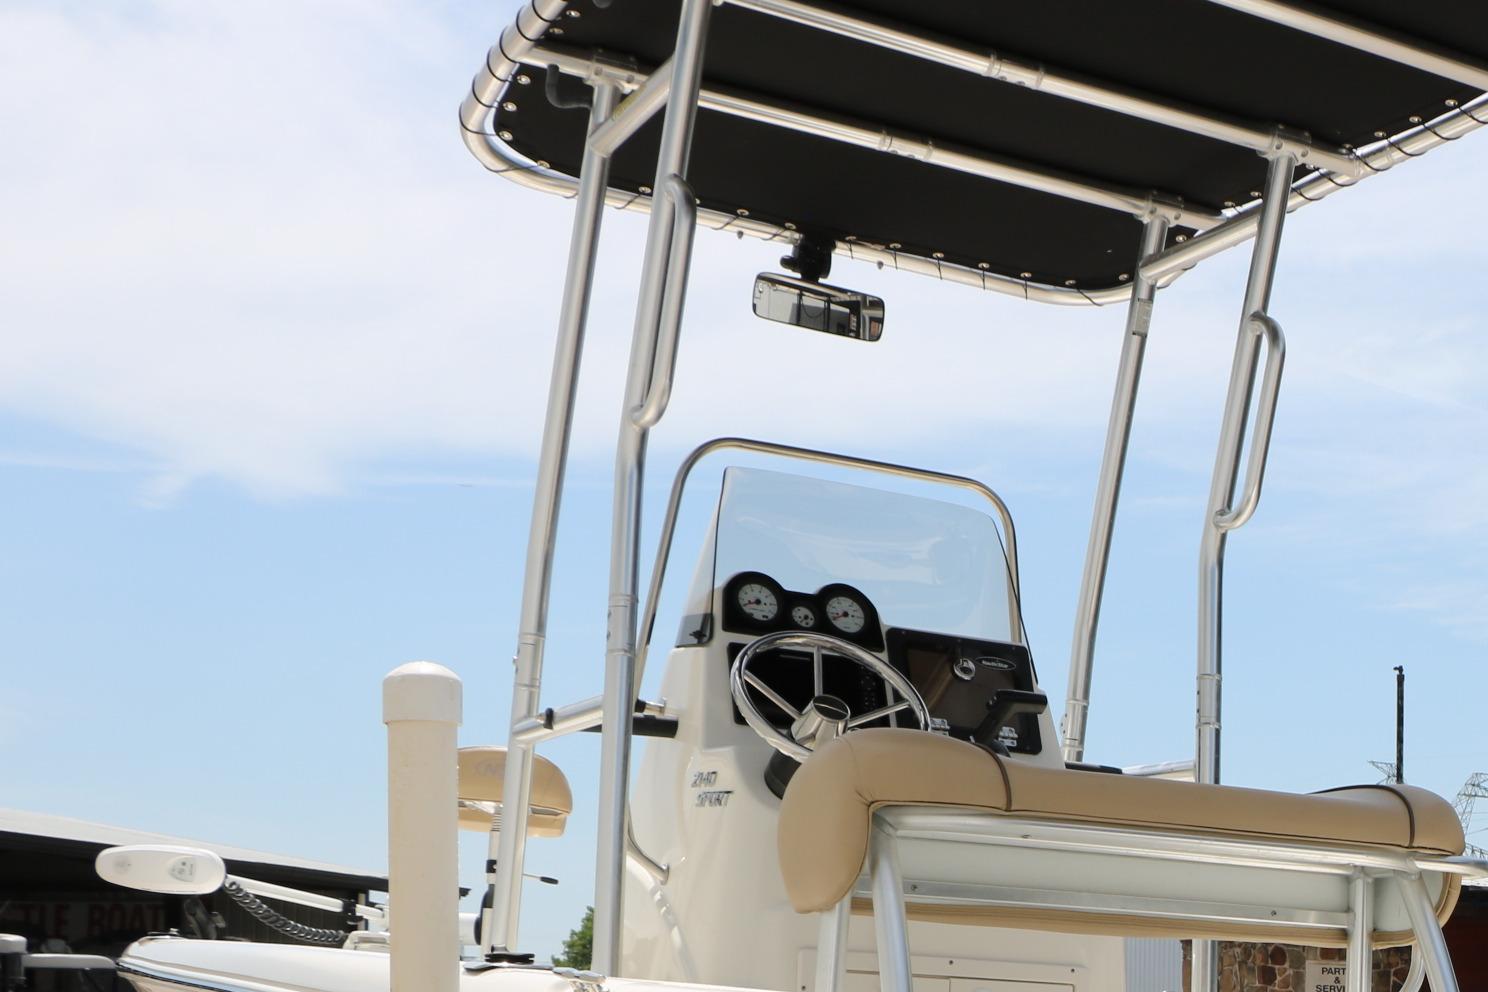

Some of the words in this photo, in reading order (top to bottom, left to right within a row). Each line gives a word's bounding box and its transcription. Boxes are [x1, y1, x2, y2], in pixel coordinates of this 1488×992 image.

[1321, 967, 1346, 975] PART
[1334, 976, 1341, 984] &
[1315, 984, 1345, 992] SERVI
